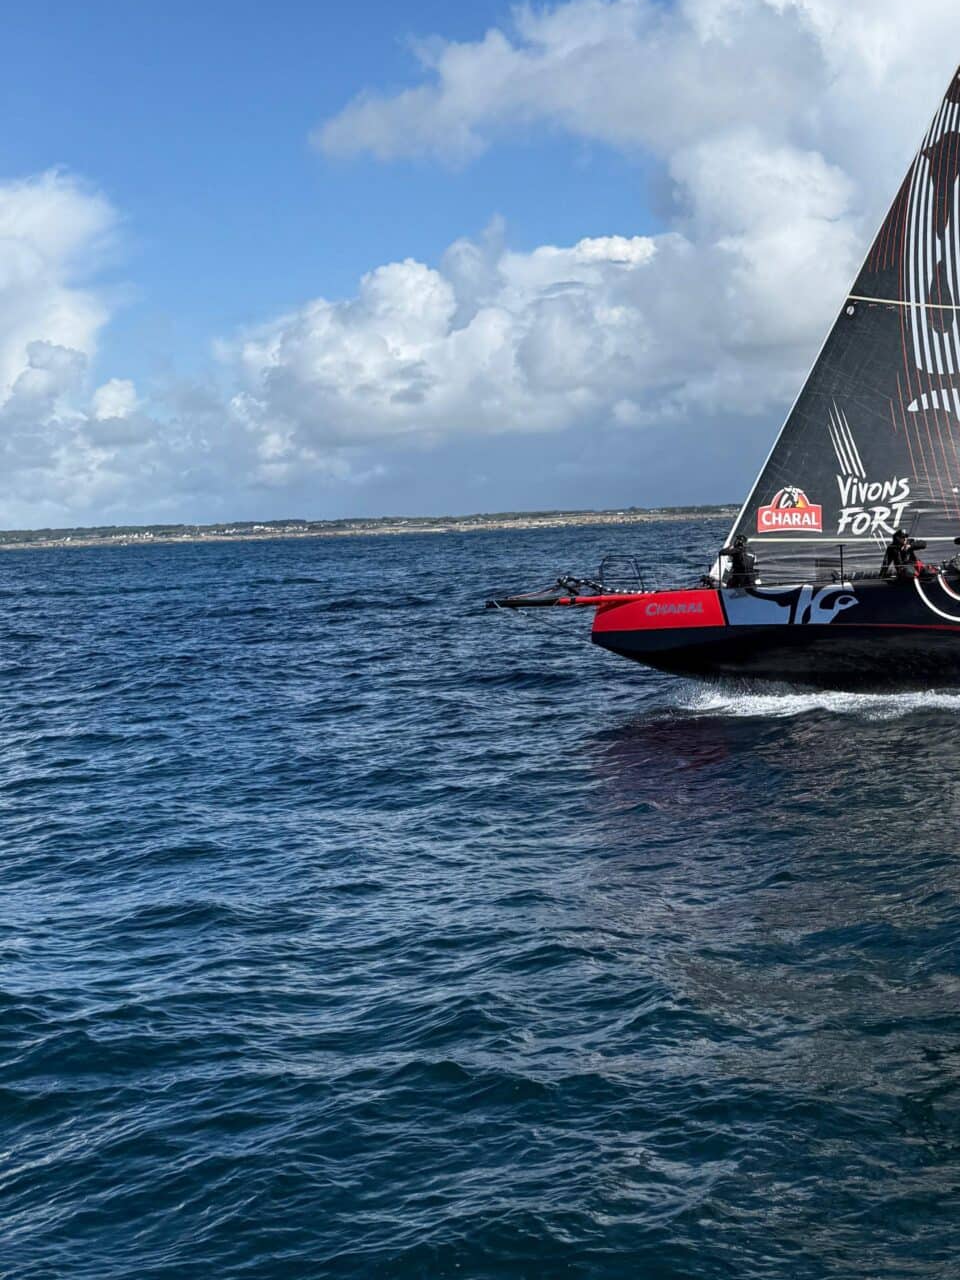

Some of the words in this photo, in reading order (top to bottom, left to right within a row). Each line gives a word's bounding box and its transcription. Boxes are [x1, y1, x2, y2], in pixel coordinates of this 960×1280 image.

[761, 510, 819, 526] CHARAL
[837, 501, 913, 536] FORT
[645, 601, 704, 617] CHARAL
